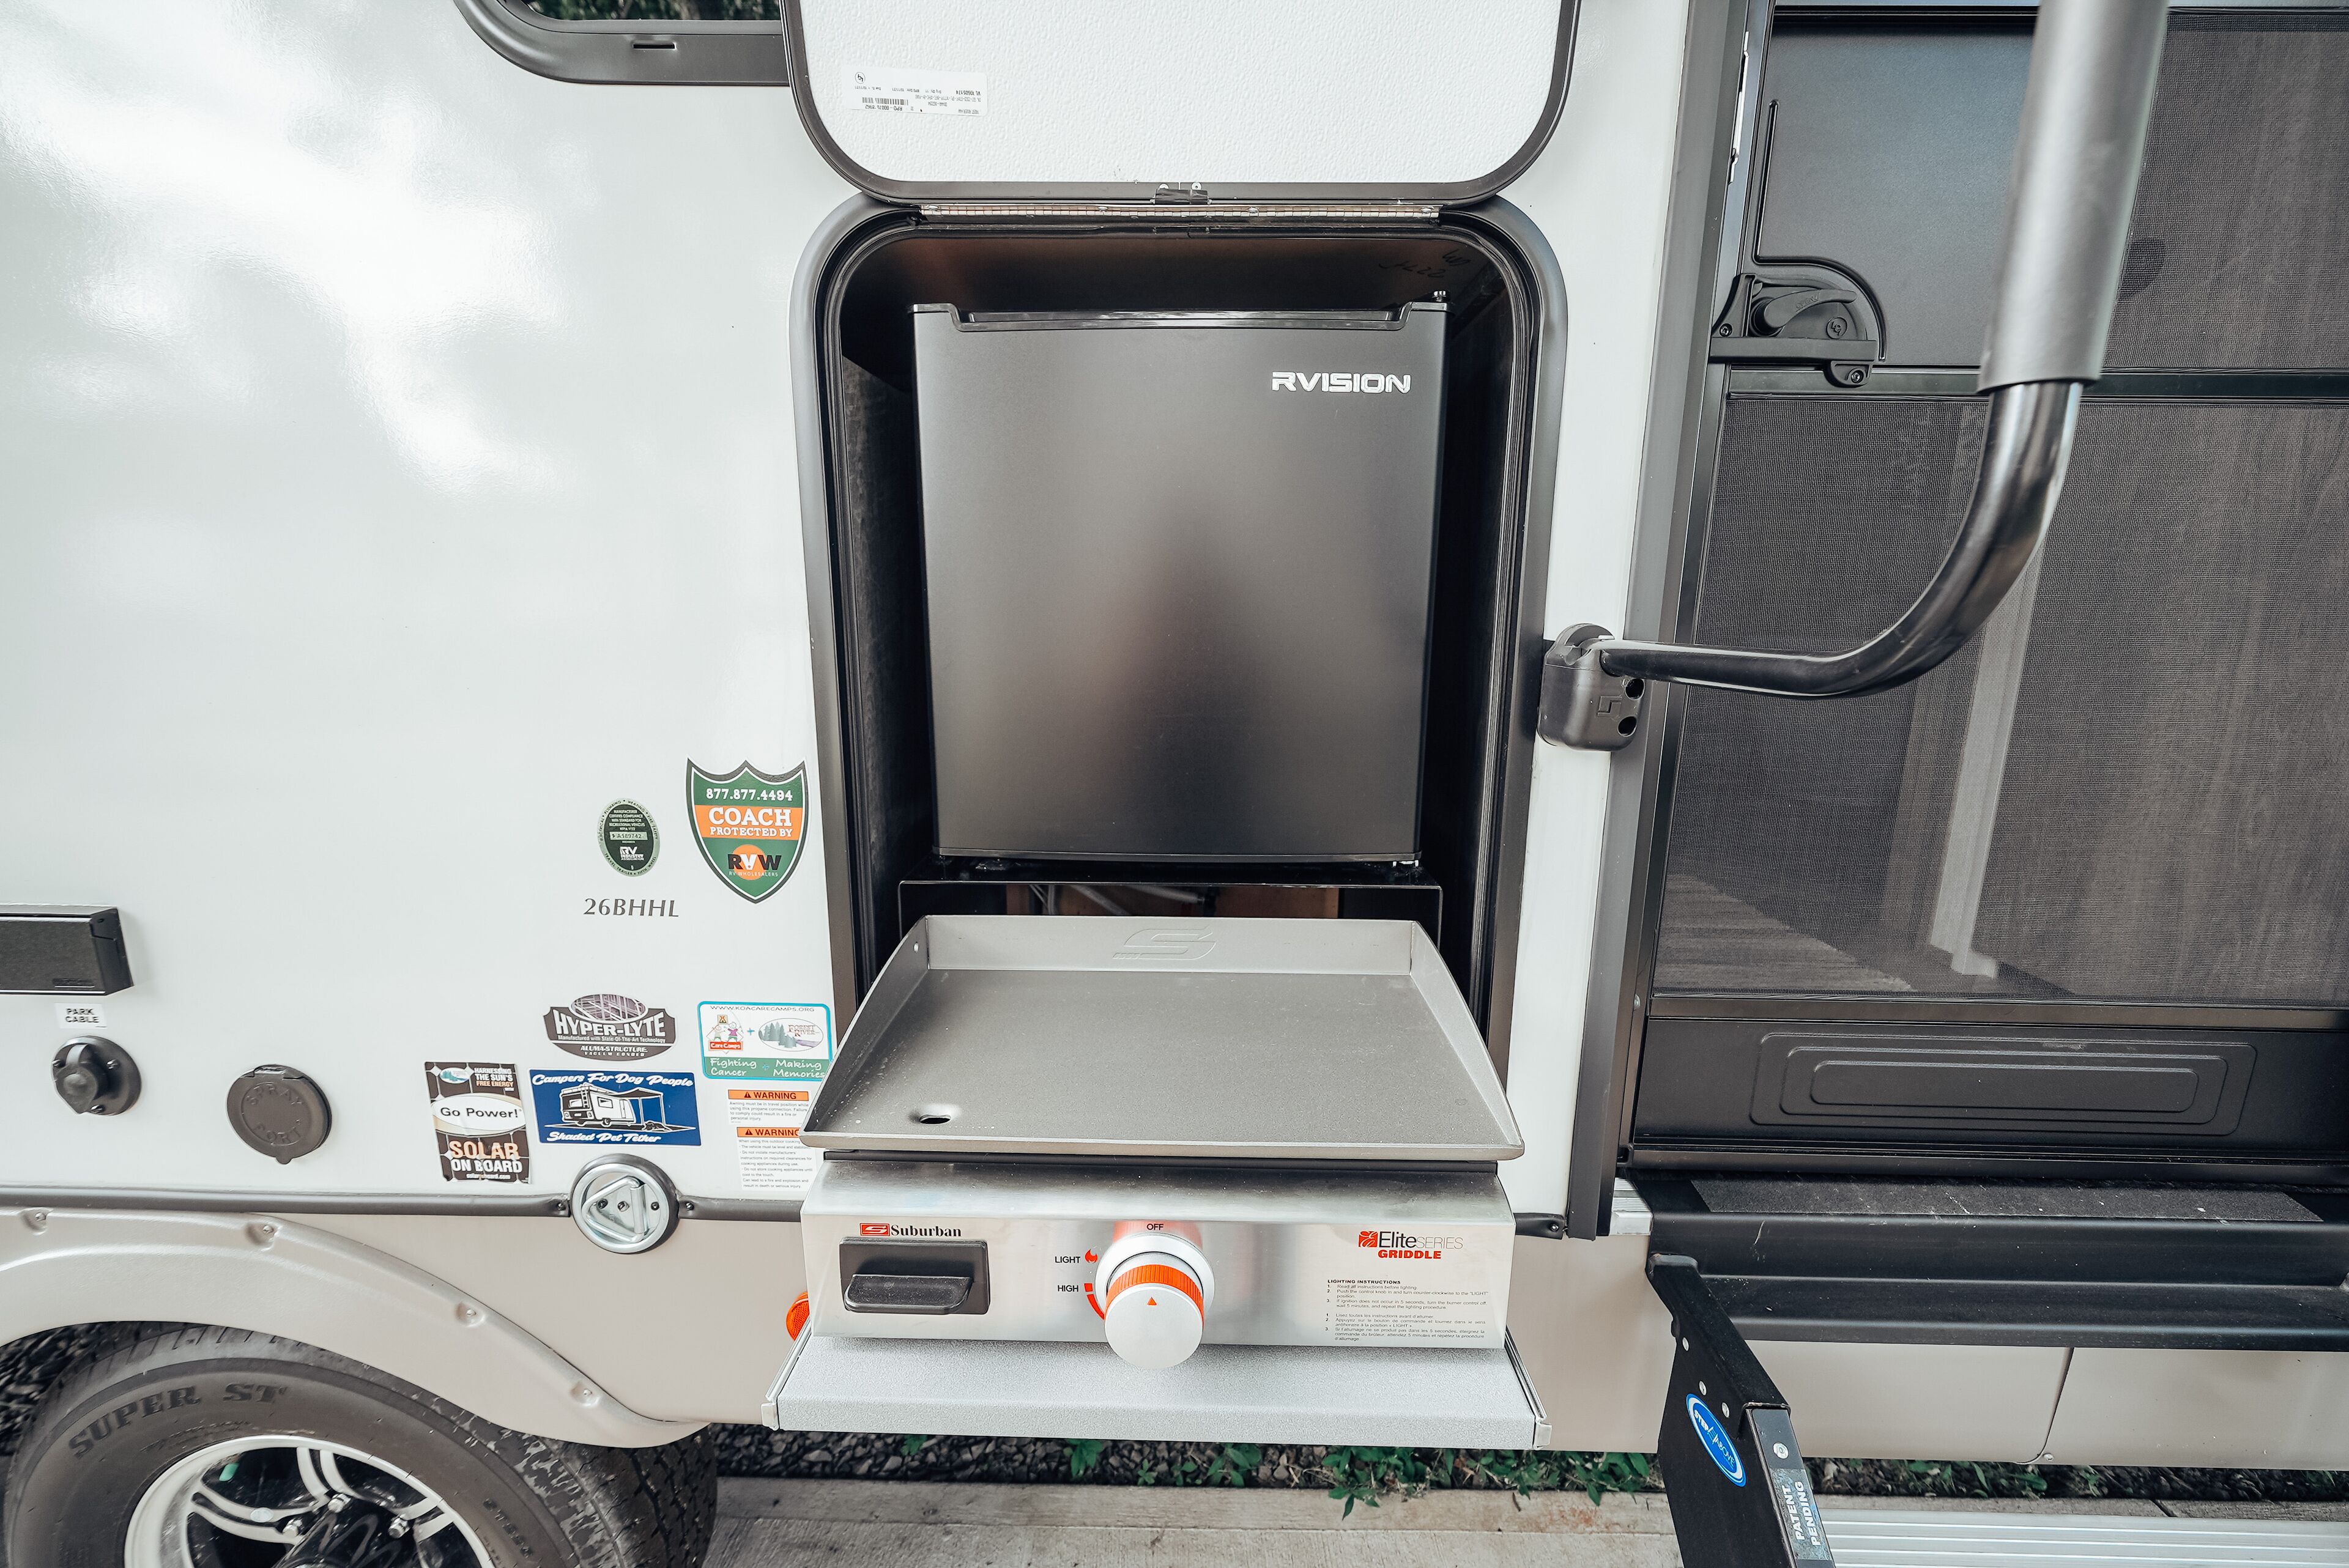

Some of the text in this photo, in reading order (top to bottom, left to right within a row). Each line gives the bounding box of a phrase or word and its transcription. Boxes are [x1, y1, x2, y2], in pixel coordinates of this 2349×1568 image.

[1272, 371, 1411, 394] RVISION
[706, 788, 793, 801] 877.877.4494
[708, 807, 792, 827] COACH
[710, 827, 793, 837] PROTECTED BY
[727, 854, 782, 870] RVW
[583, 898, 679, 917] 26BHHL
[552, 1009, 666, 1037] HYPER-LYTE
[710, 1057, 822, 1070] Fighting Making
[711, 1067, 747, 1076] Cancer
[532, 1073, 694, 1087] Campers For Dog People
[440, 1108, 518, 1118] Go Power!
[547, 1131, 661, 1143] Shaded Pet Tether
[449, 1141, 521, 1160] SOLAR
[450, 1159, 523, 1173] ON BOARD
[891, 1224, 962, 1237] Suburban
[1378, 1249, 1442, 1259] GRIDDLE
[69, 1385, 201, 1460] SUPER
[223, 1383, 288, 1405] ST
[1783, 1485, 1805, 1541] PATENT
[1794, 1481, 1821, 1546] PENDING
